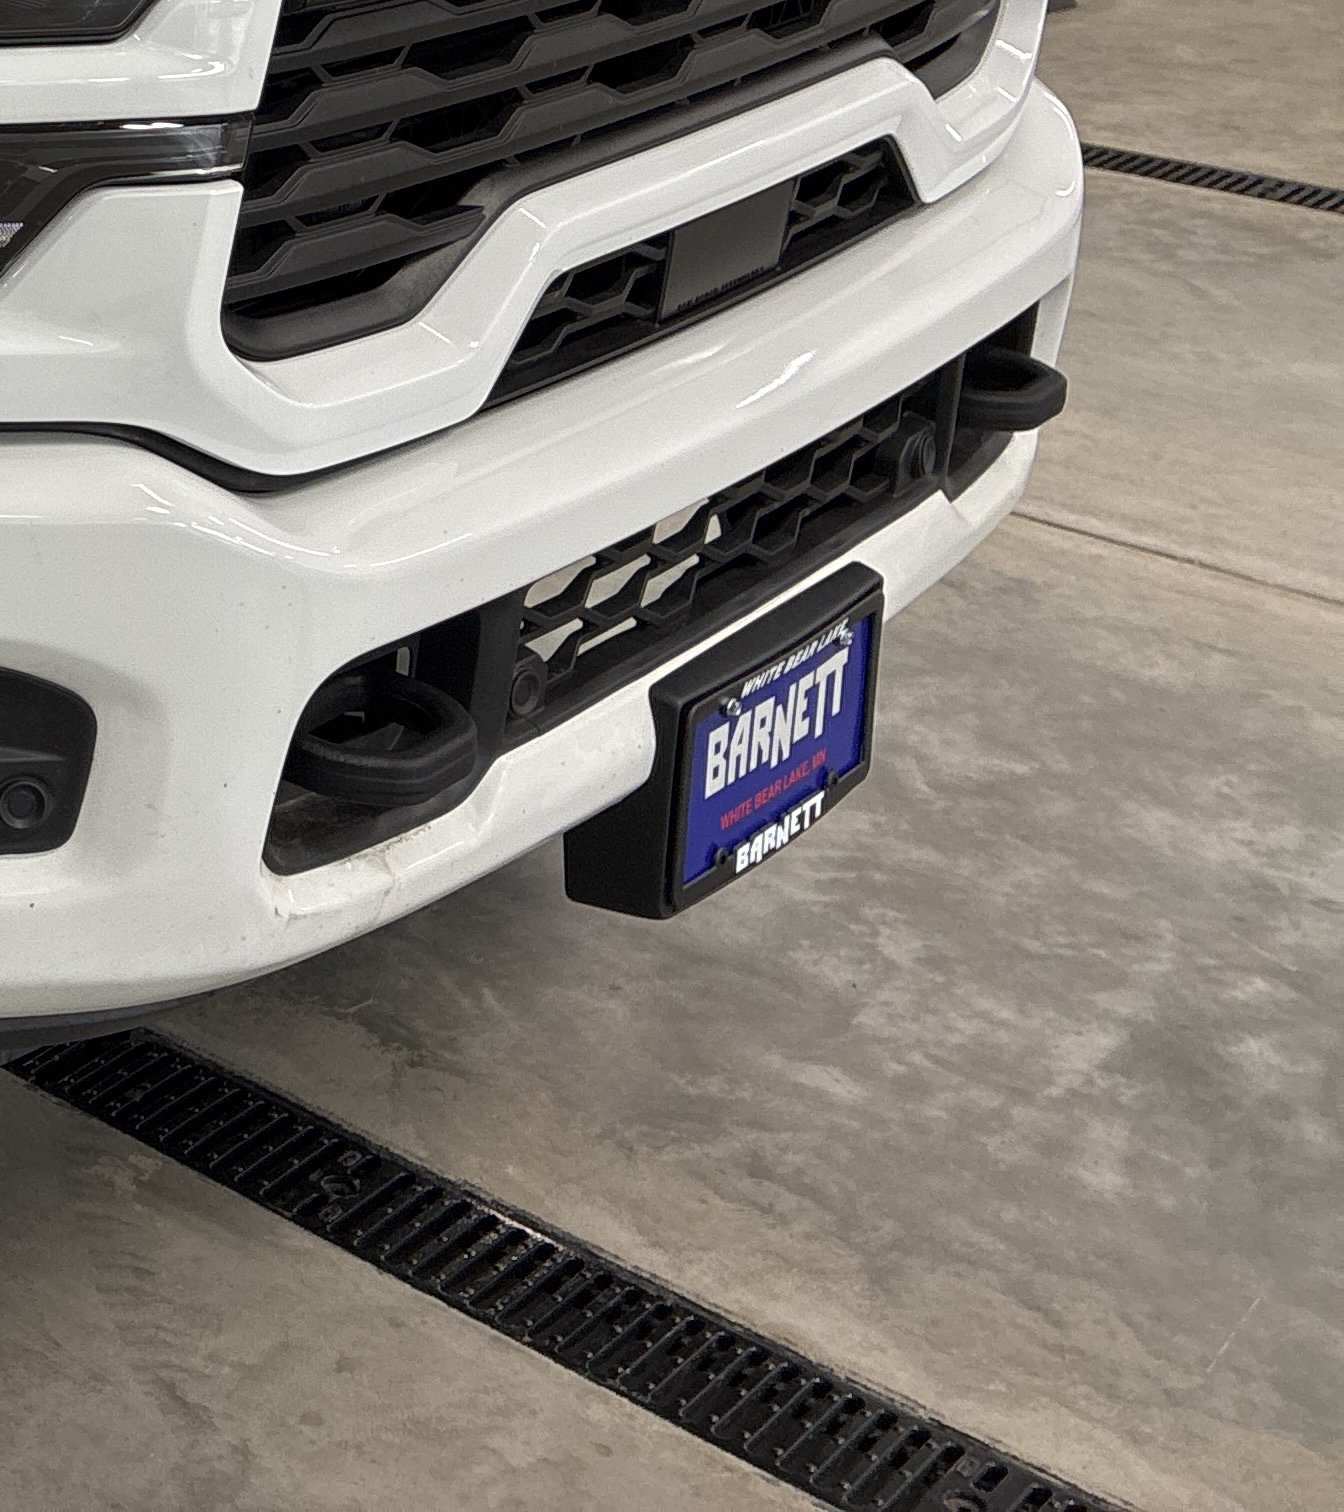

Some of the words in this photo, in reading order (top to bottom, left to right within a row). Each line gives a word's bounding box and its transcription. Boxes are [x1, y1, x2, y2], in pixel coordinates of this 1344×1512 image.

[740, 660, 786, 699] WHITE
[783, 639, 819, 675] BEAR
[704, 646, 849, 800] BARNETT
[719, 797, 754, 830] WHITE
[754, 778, 782, 810] BEAR
[735, 789, 826, 874] BARNETT
